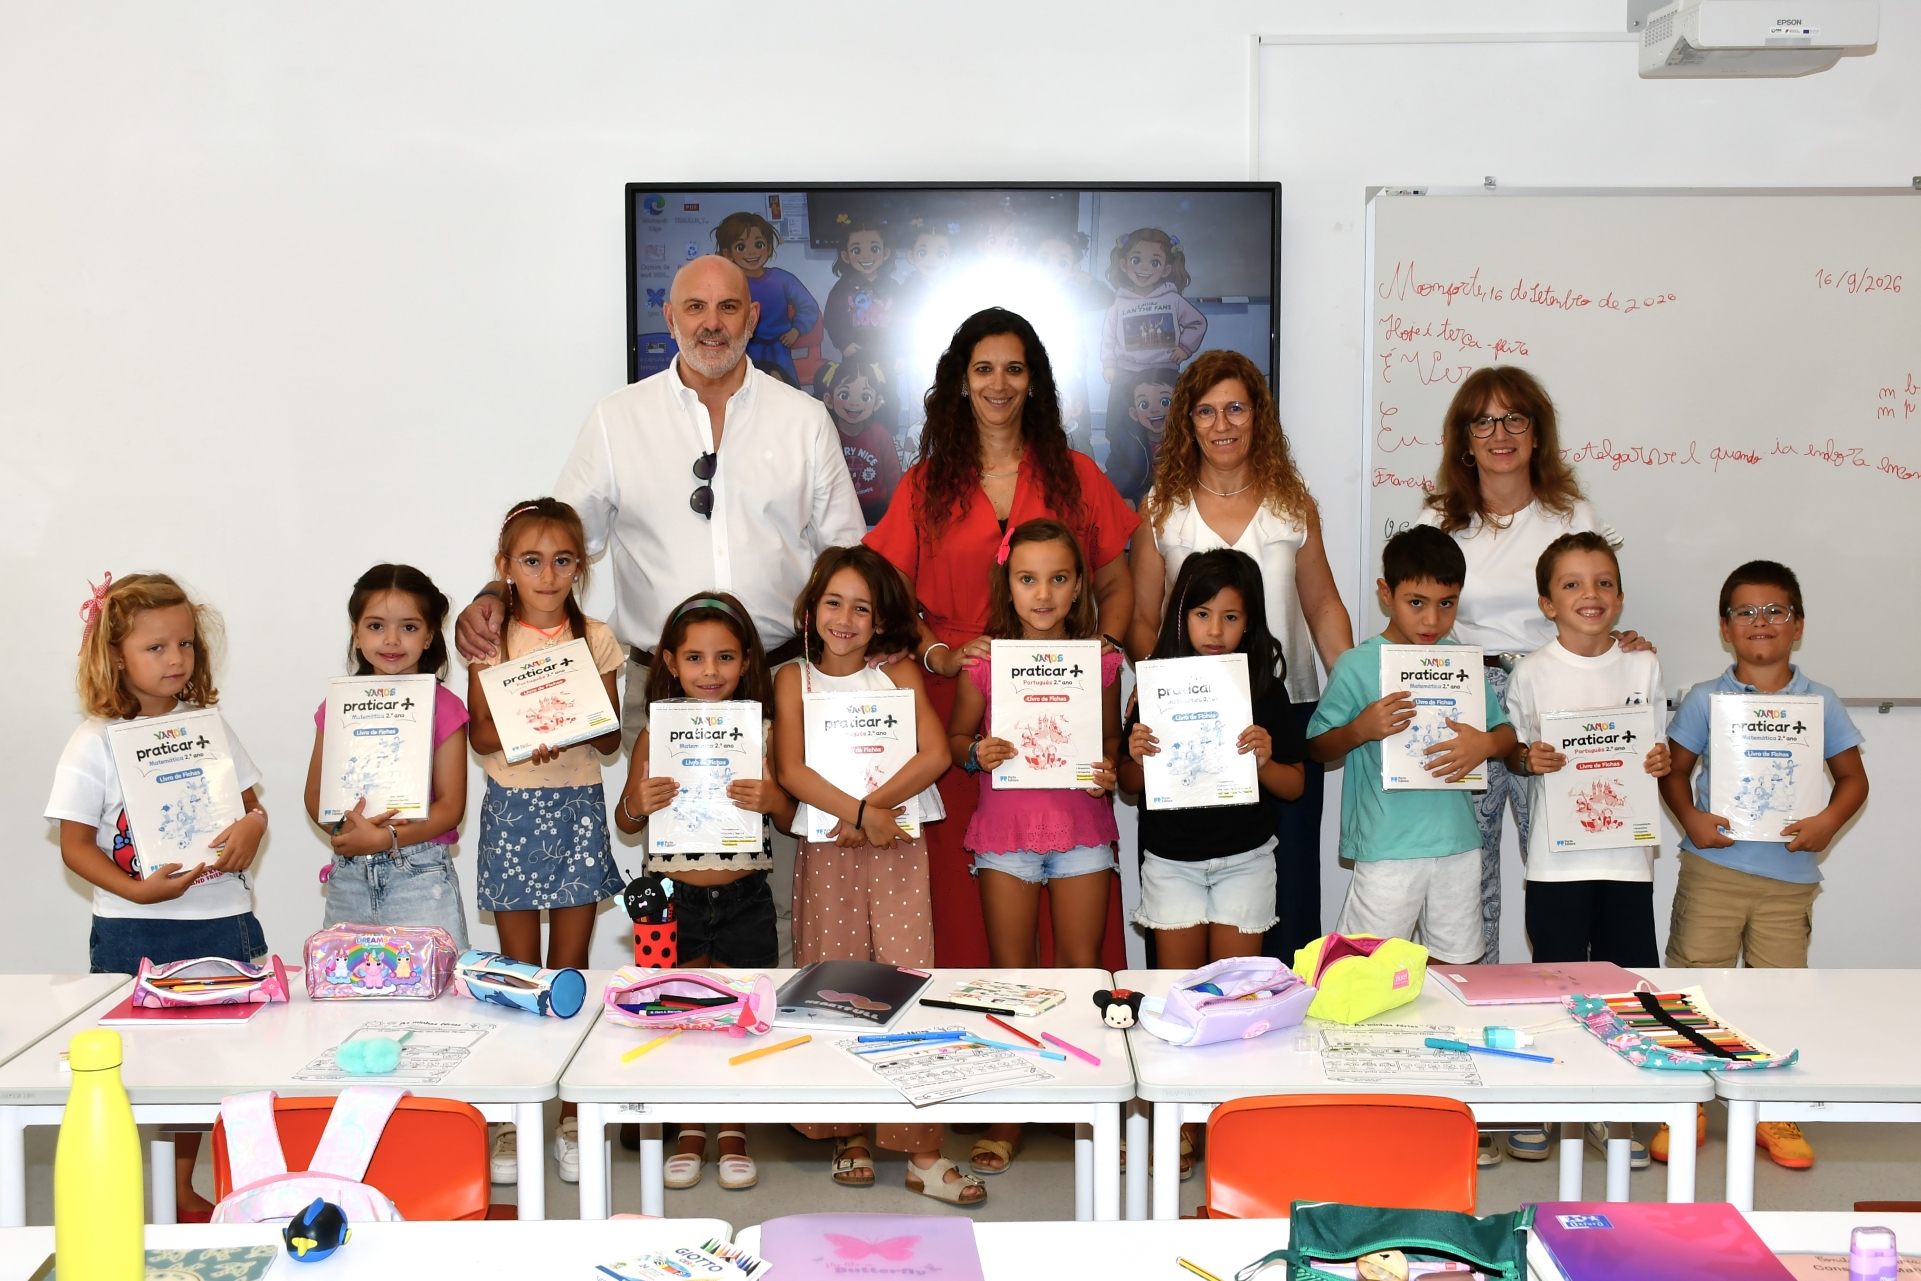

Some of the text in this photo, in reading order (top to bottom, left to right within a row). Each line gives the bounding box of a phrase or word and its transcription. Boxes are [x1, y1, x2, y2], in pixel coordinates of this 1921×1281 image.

[1598, 292, 1620, 310] de
[844, 446, 878, 466] RY NICE
[520, 657, 551, 670] VAMOS
[1032, 654, 1063, 663] VAMOS
[1420, 658, 1450, 668] VAMOS
[502, 663, 557, 687] praticar
[1012, 665, 1067, 679] praticar
[1401, 669, 1454, 682] praticar
[546, 680, 564, 689] Fichas
[365, 688, 396, 697] VAMOS
[344, 699, 398, 714] praticar
[1754, 709, 1786, 719] VAMOS
[1582, 722, 1615, 731] VAMOS
[154, 727, 187, 740] VAMOS
[670, 728, 727, 742] praticar
[1563, 734, 1619, 749] praticar
[136, 740, 194, 761] praticar
[159, 774, 174, 783] Livro
[183, 769, 200, 779] Fichas
[206, 871, 225, 881] FRIEN
[356, 936, 389, 944] DREAMS
[675, 1248, 723, 1272] GIOTTO
[835, 1266, 926, 1276] Butterfly
